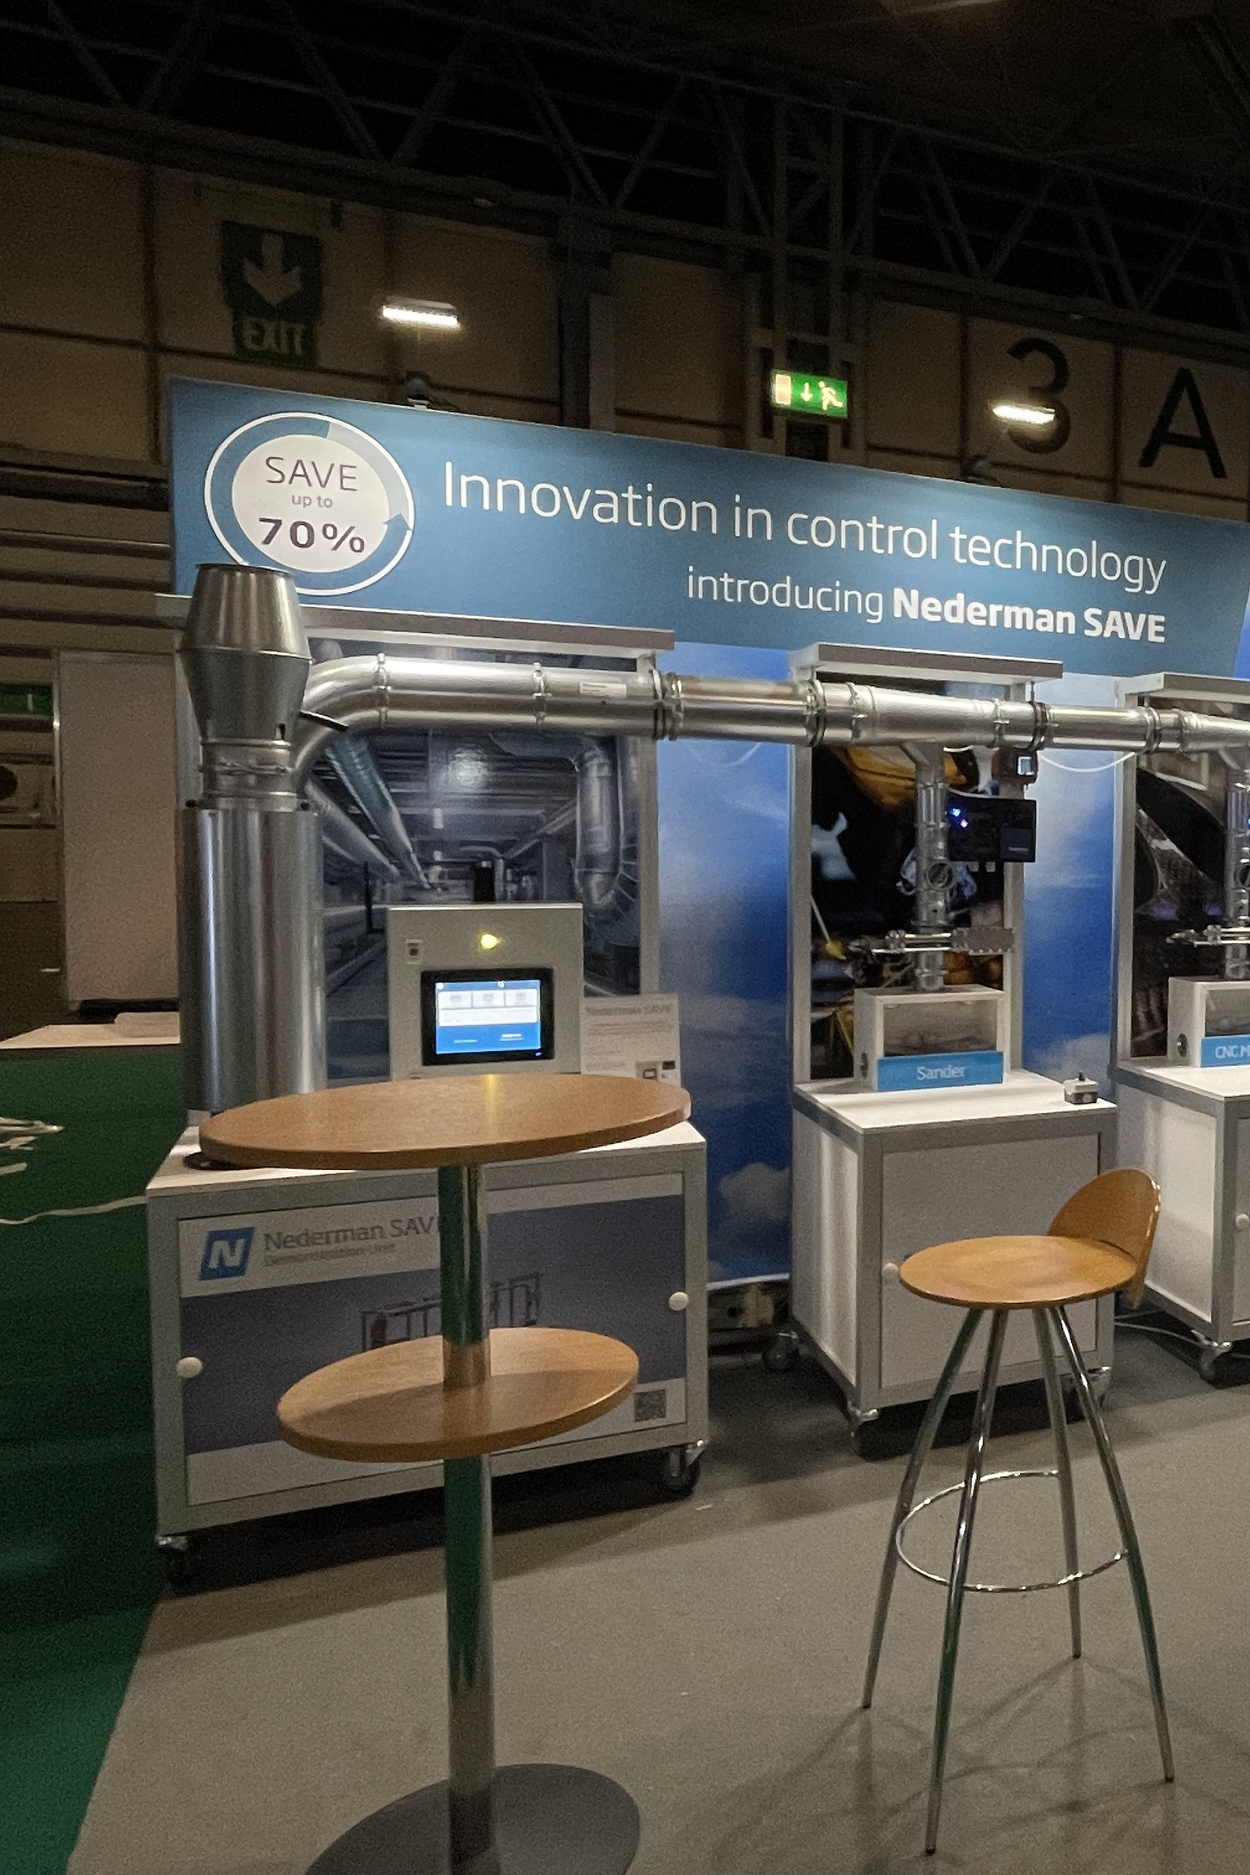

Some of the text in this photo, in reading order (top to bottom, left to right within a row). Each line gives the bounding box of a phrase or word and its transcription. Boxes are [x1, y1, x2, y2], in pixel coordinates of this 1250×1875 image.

[242, 316, 306, 356] EXIT
[1007, 337, 1228, 479] 3 A
[265, 455, 358, 492] SAVE
[291, 493, 333, 509] up to
[258, 516, 365, 555] 70%
[445, 461, 1166, 595] Innovation in control technology
[688, 565, 1165, 643] introducing Nederman SAVE
[1214, 1045, 1239, 1060] CNC
[916, 1064, 966, 1081] Sander
[264, 1216, 435, 1252] Nederman SAV
